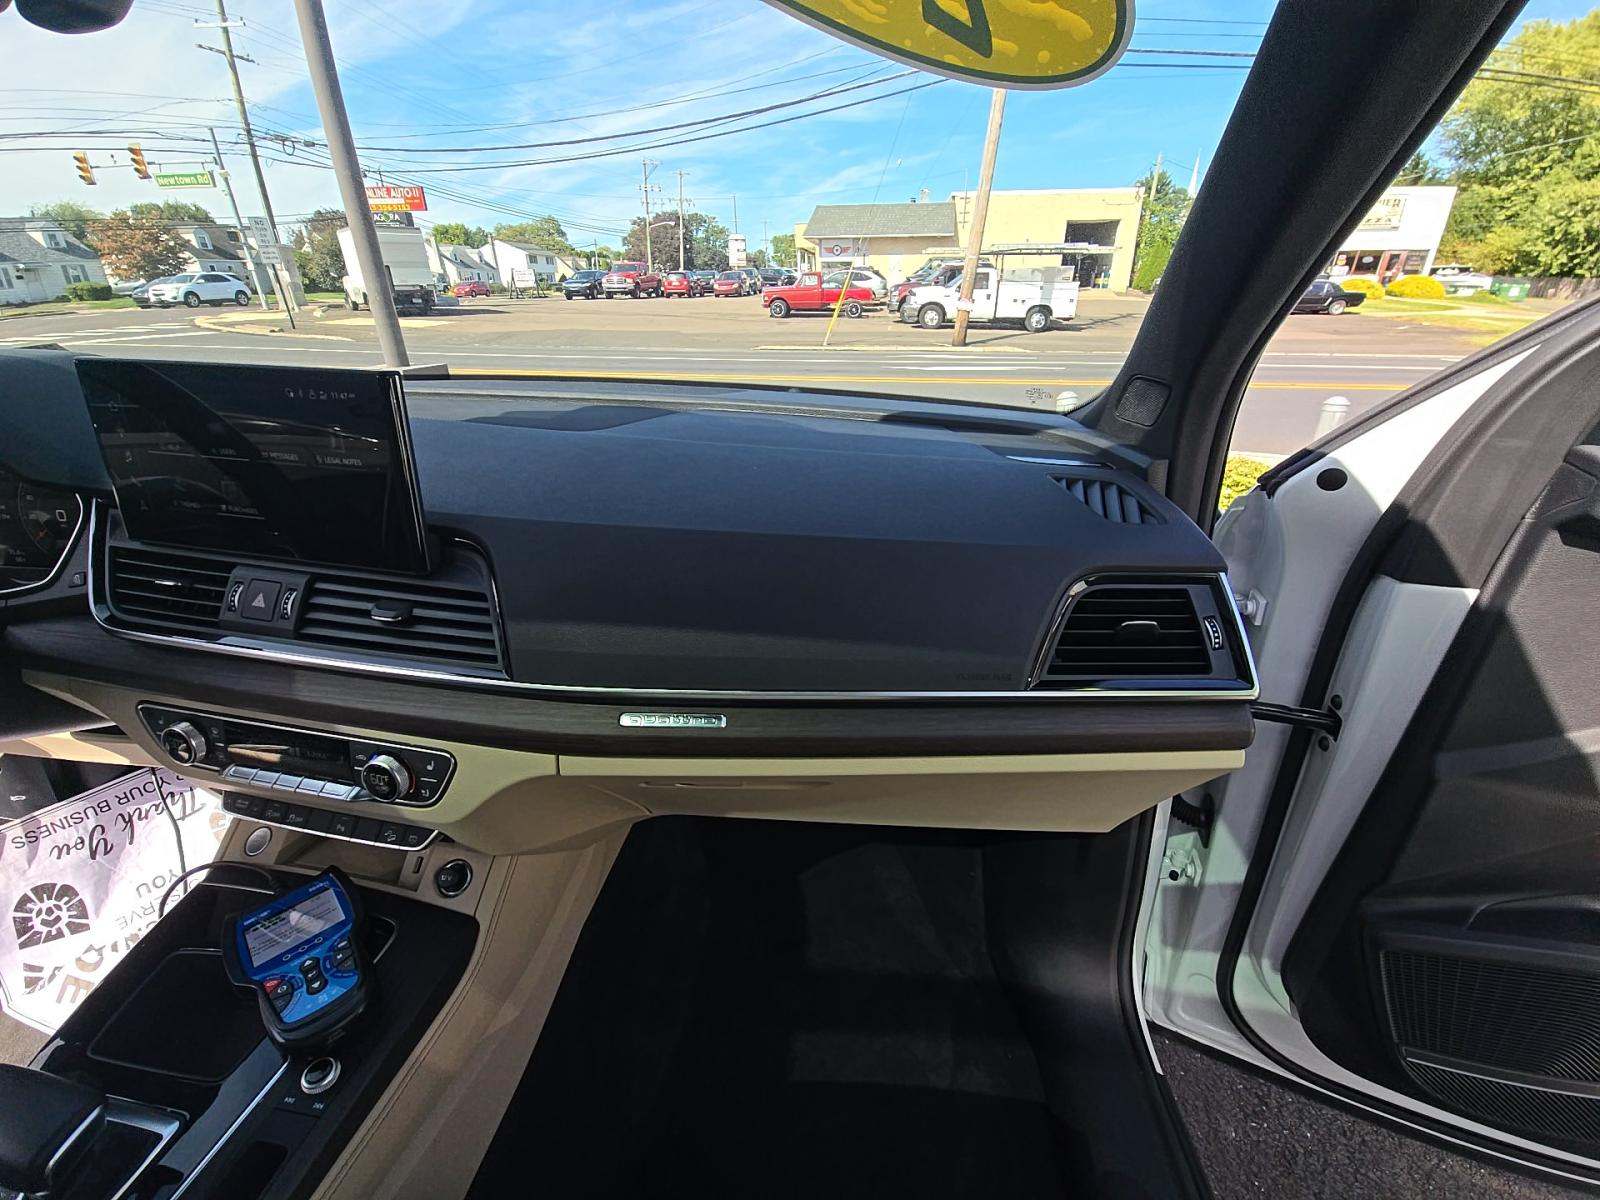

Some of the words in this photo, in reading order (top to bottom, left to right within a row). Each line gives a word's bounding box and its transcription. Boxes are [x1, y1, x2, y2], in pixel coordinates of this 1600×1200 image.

[157, 176, 197, 186] Newtown
[197, 175, 209, 184] Rd
[365, 187, 389, 198] NLINE
[114, 779, 171, 806] YOUR
[11, 801, 111, 850] BUSINESS
[49, 823, 114, 861] You
[136, 869, 182, 898] YOU
